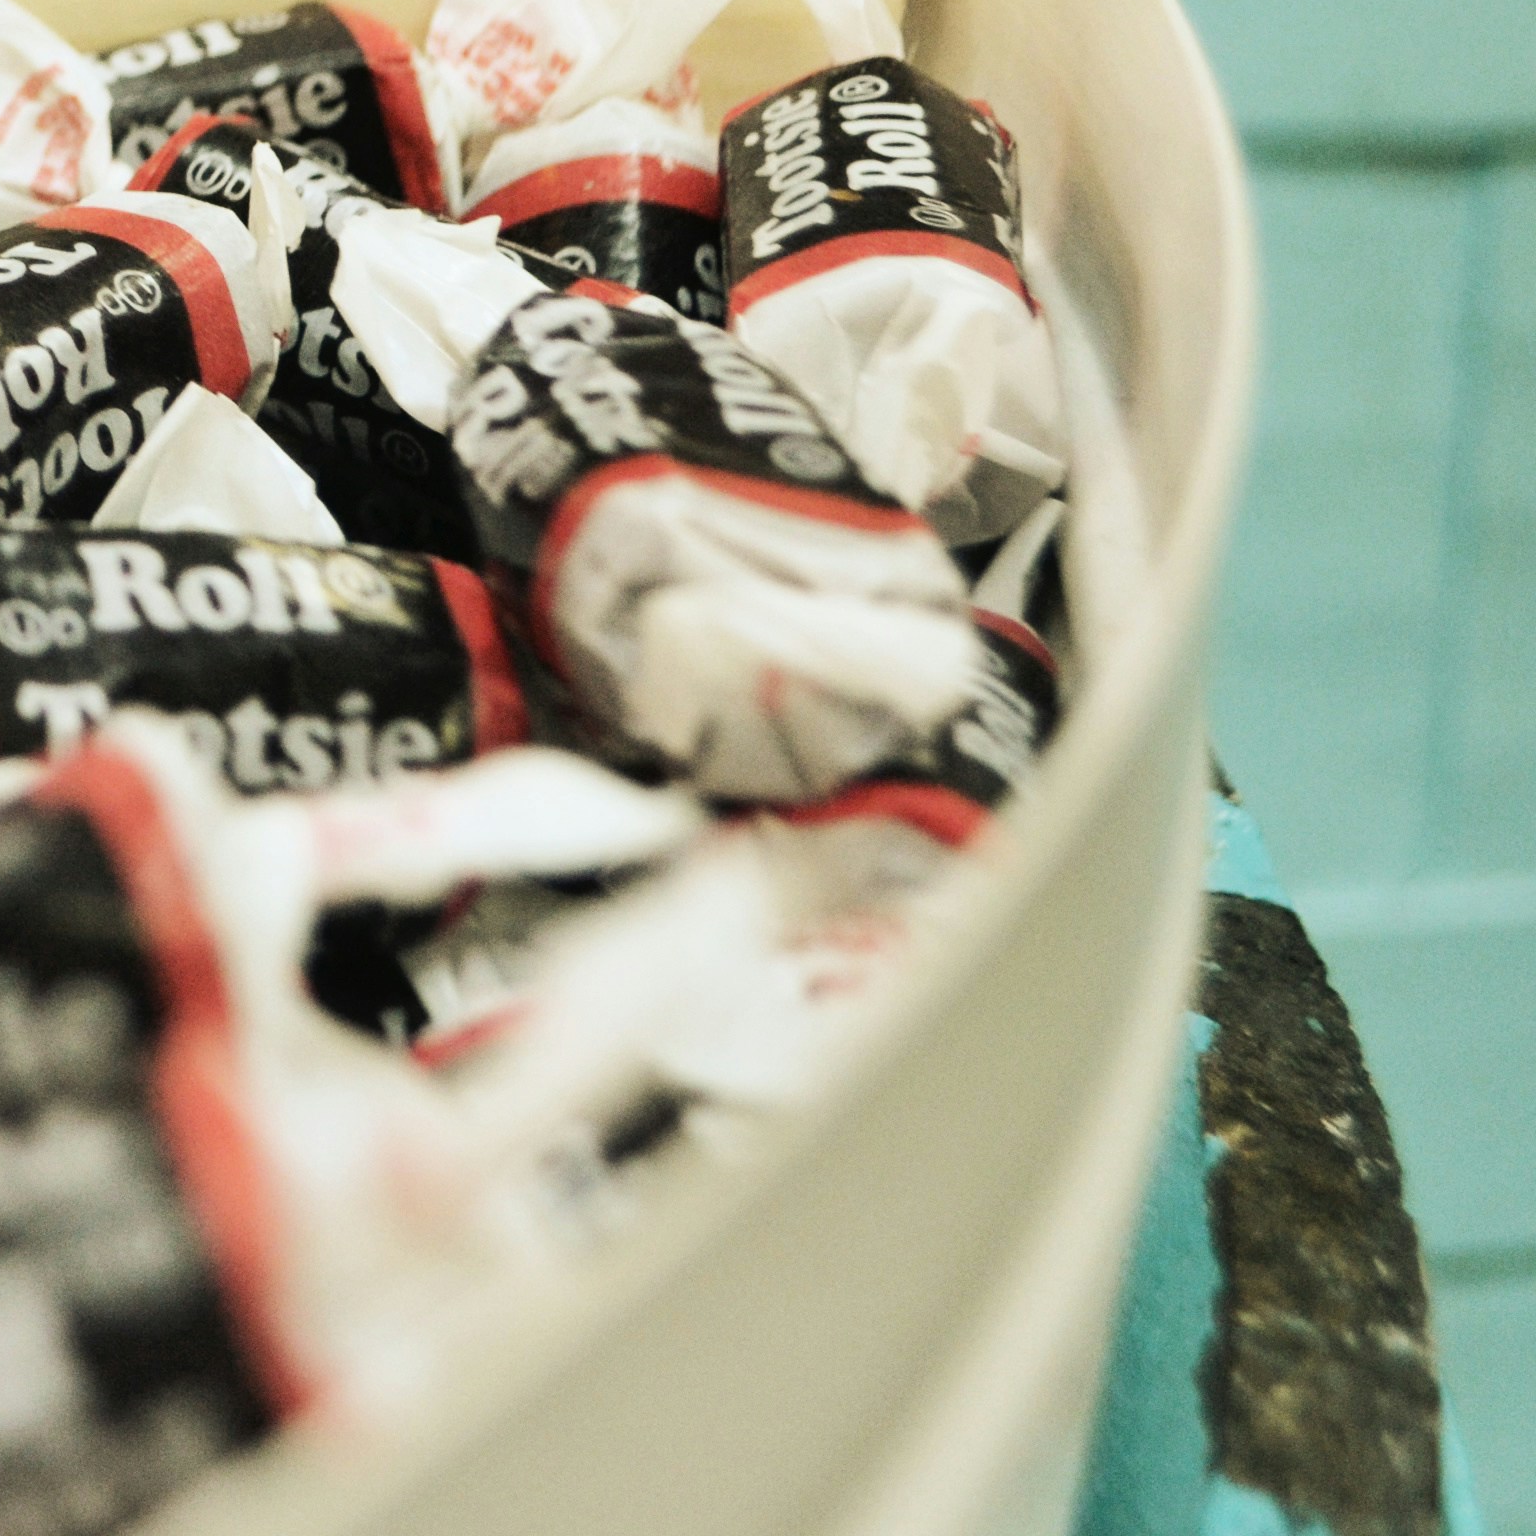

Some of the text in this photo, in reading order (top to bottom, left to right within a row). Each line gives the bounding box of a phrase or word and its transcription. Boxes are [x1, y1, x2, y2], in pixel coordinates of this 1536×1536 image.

[100, 19, 244, 80] oll
[742, 86, 838, 260] Tootsie
[78, 538, 342, 632] Roll
